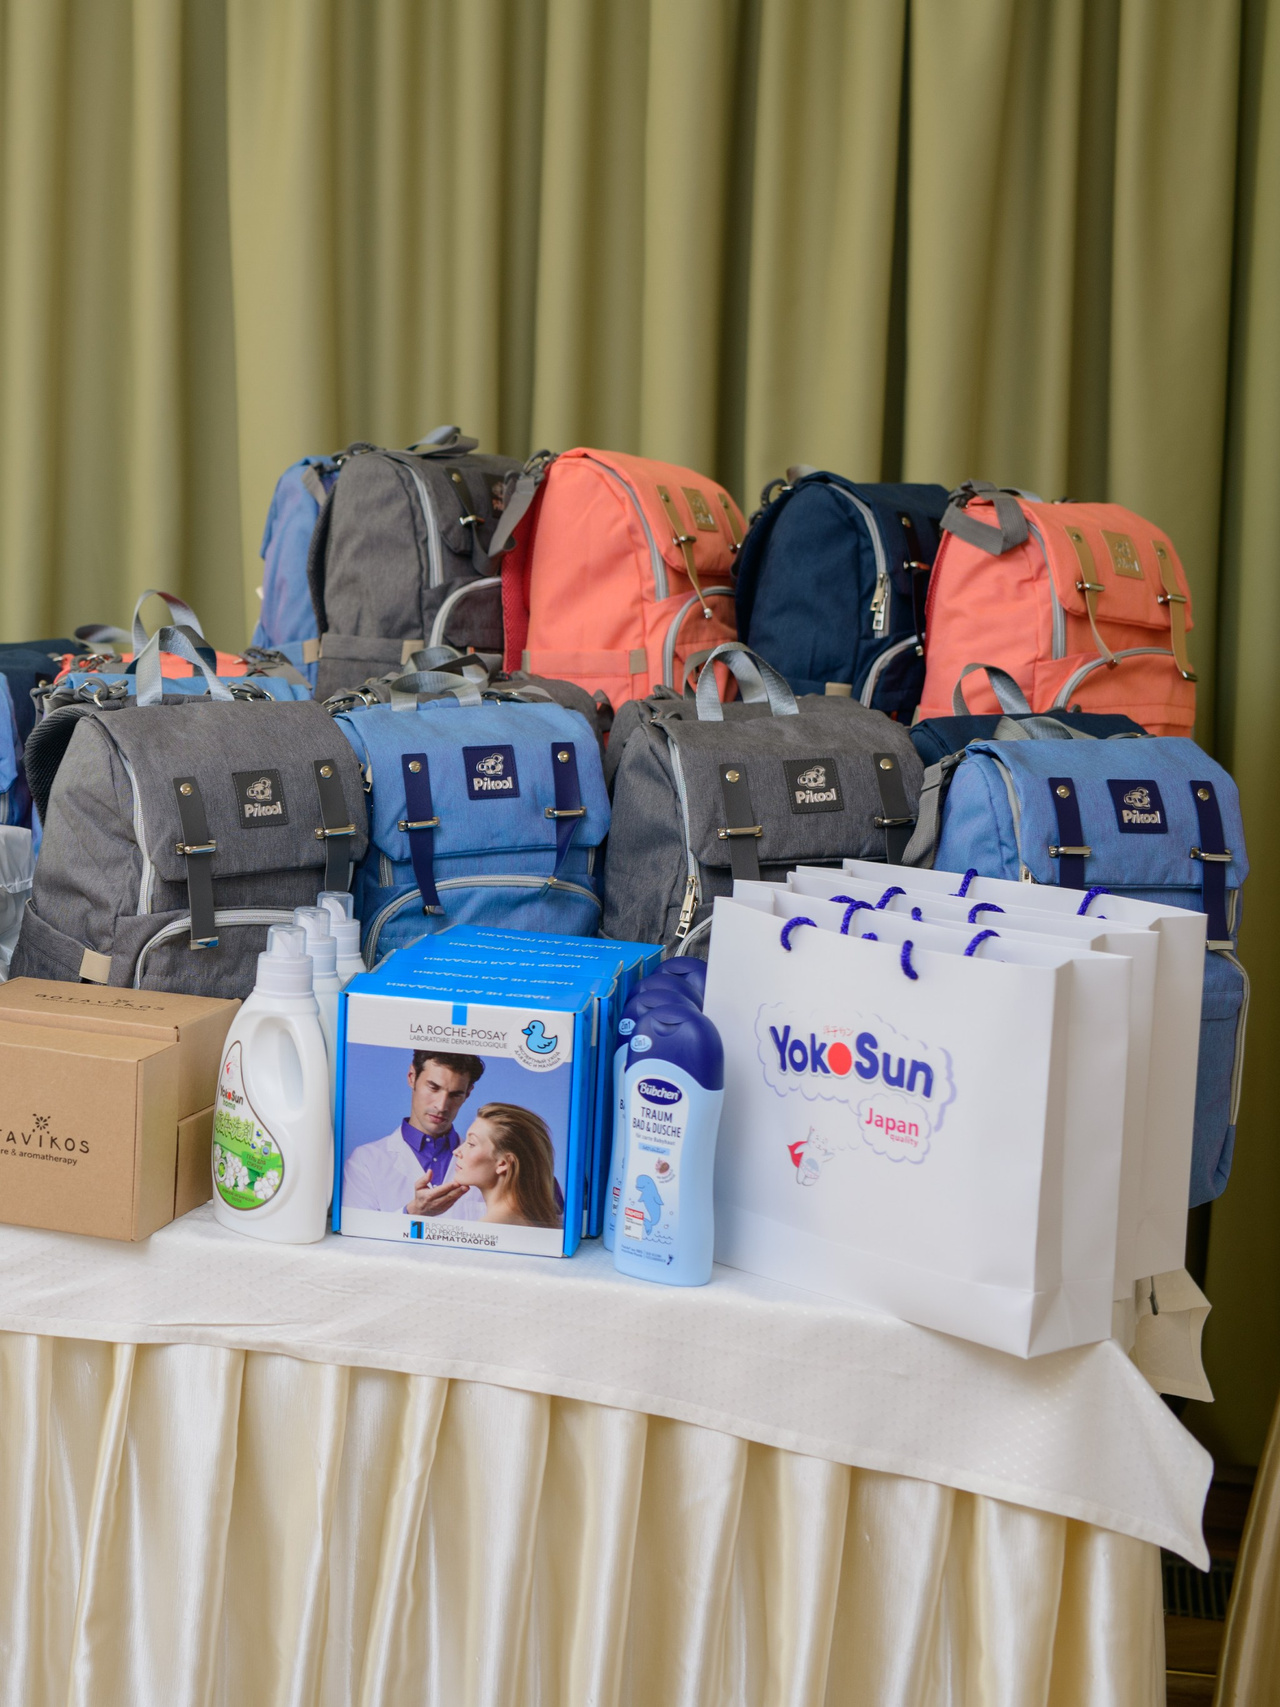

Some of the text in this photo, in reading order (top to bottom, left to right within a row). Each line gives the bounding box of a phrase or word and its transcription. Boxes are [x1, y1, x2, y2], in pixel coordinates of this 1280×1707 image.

[472, 776, 513, 790] Pikool
[795, 788, 837, 804] Pikool
[244, 801, 282, 818] Pikool
[1122, 810, 1161, 824] Pikool
[424, 956, 488, 965] ПРОДАЖИ
[413, 970, 478, 979] ПРОДАЖИ
[386, 982, 453, 992] ПРОДАЖИ
[410, 1024, 508, 1041] LA ROCHE-POSAY
[410, 1034, 508, 1050] LABORATOIRE DERMATOLOGIQUE
[769, 1024, 934, 1099] YokoSun
[640, 1082, 678, 1101] Bübchen
[641, 1106, 673, 1124] TRAUM
[865, 1108, 919, 1137] Japan
[632, 1118, 682, 1138] BAD & DUSCHE
[890, 1133, 920, 1148] quality
[11, 1148, 17, 1156] &
[18, 1150, 78, 1166] aromatherapy
[412, 1221, 423, 1240] 1
[438, 1230, 498, 1241] РЕКОМЕНДАЦИИ
[426, 1234, 496, 1246] ДЕРМАТОЛОГОВ
